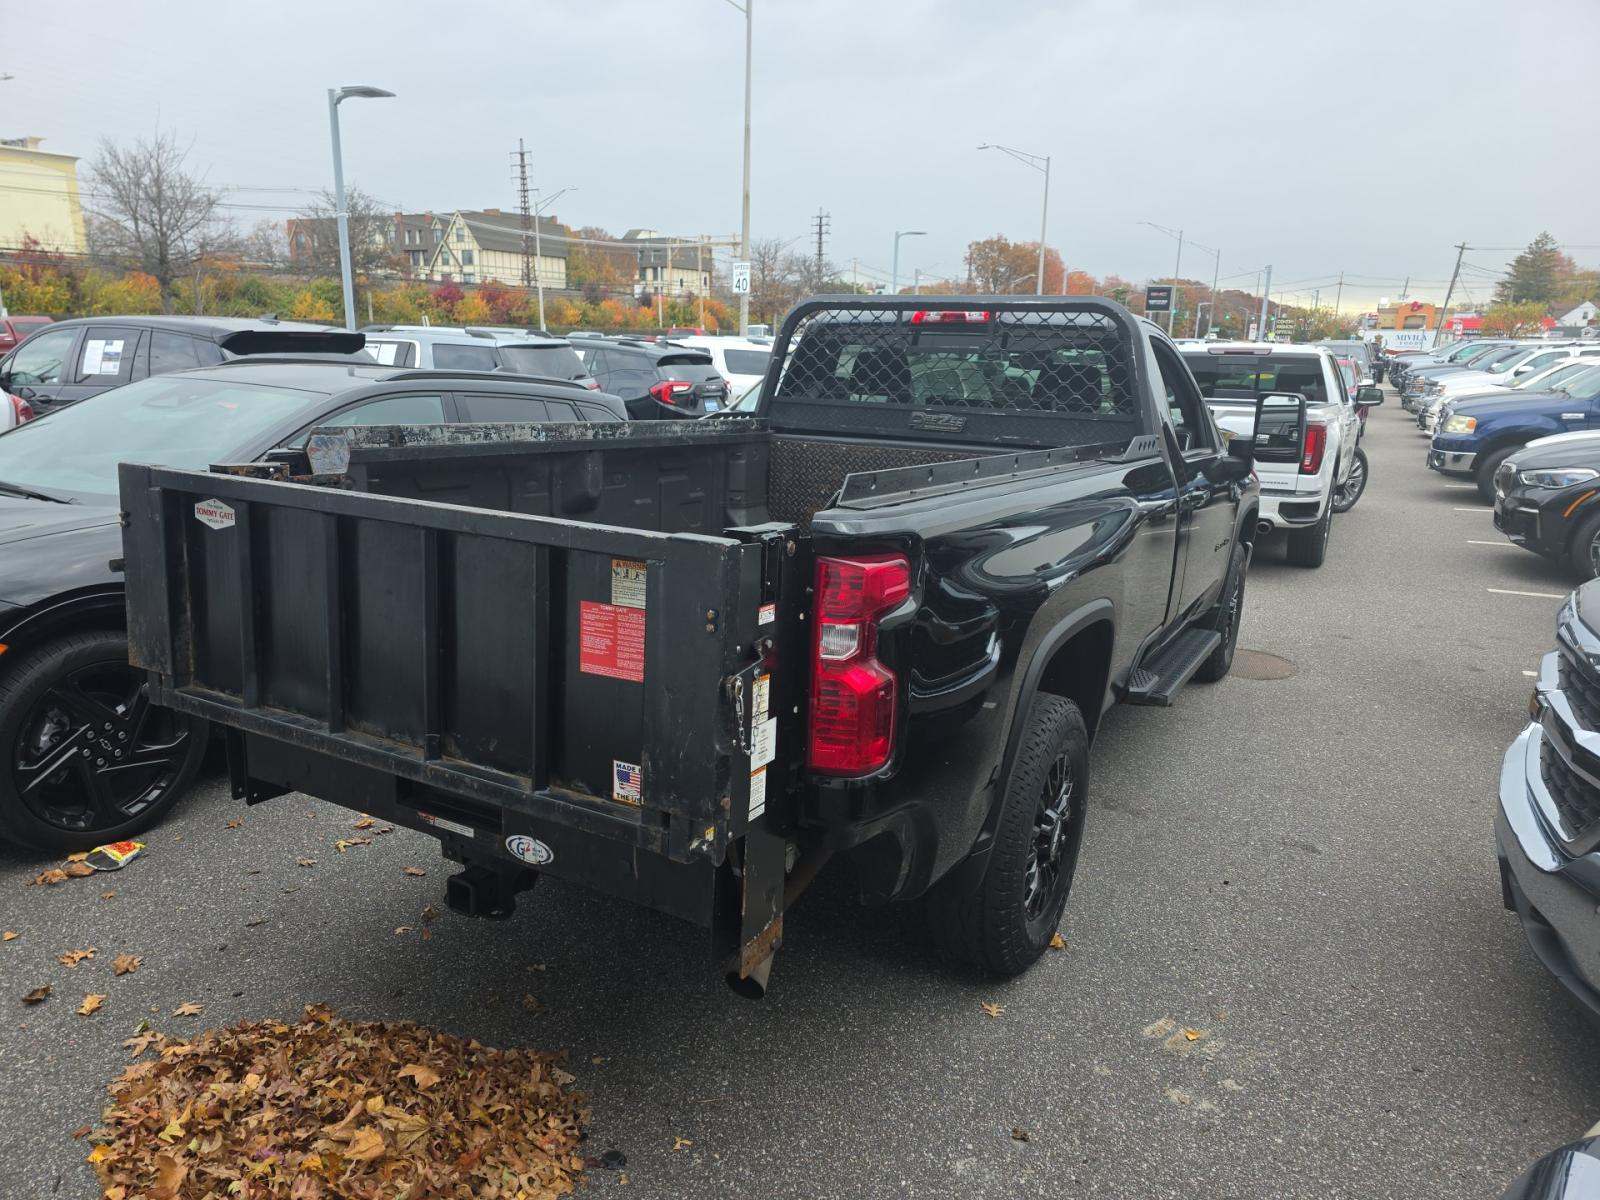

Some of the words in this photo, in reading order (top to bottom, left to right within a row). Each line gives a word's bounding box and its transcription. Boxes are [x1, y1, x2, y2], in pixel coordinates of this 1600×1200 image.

[735, 278, 748, 291] 40
[196, 506, 218, 518] TOMMY
[219, 511, 234, 521] GATE
[616, 763, 636, 772] MADE
[616, 792, 630, 800] THE
